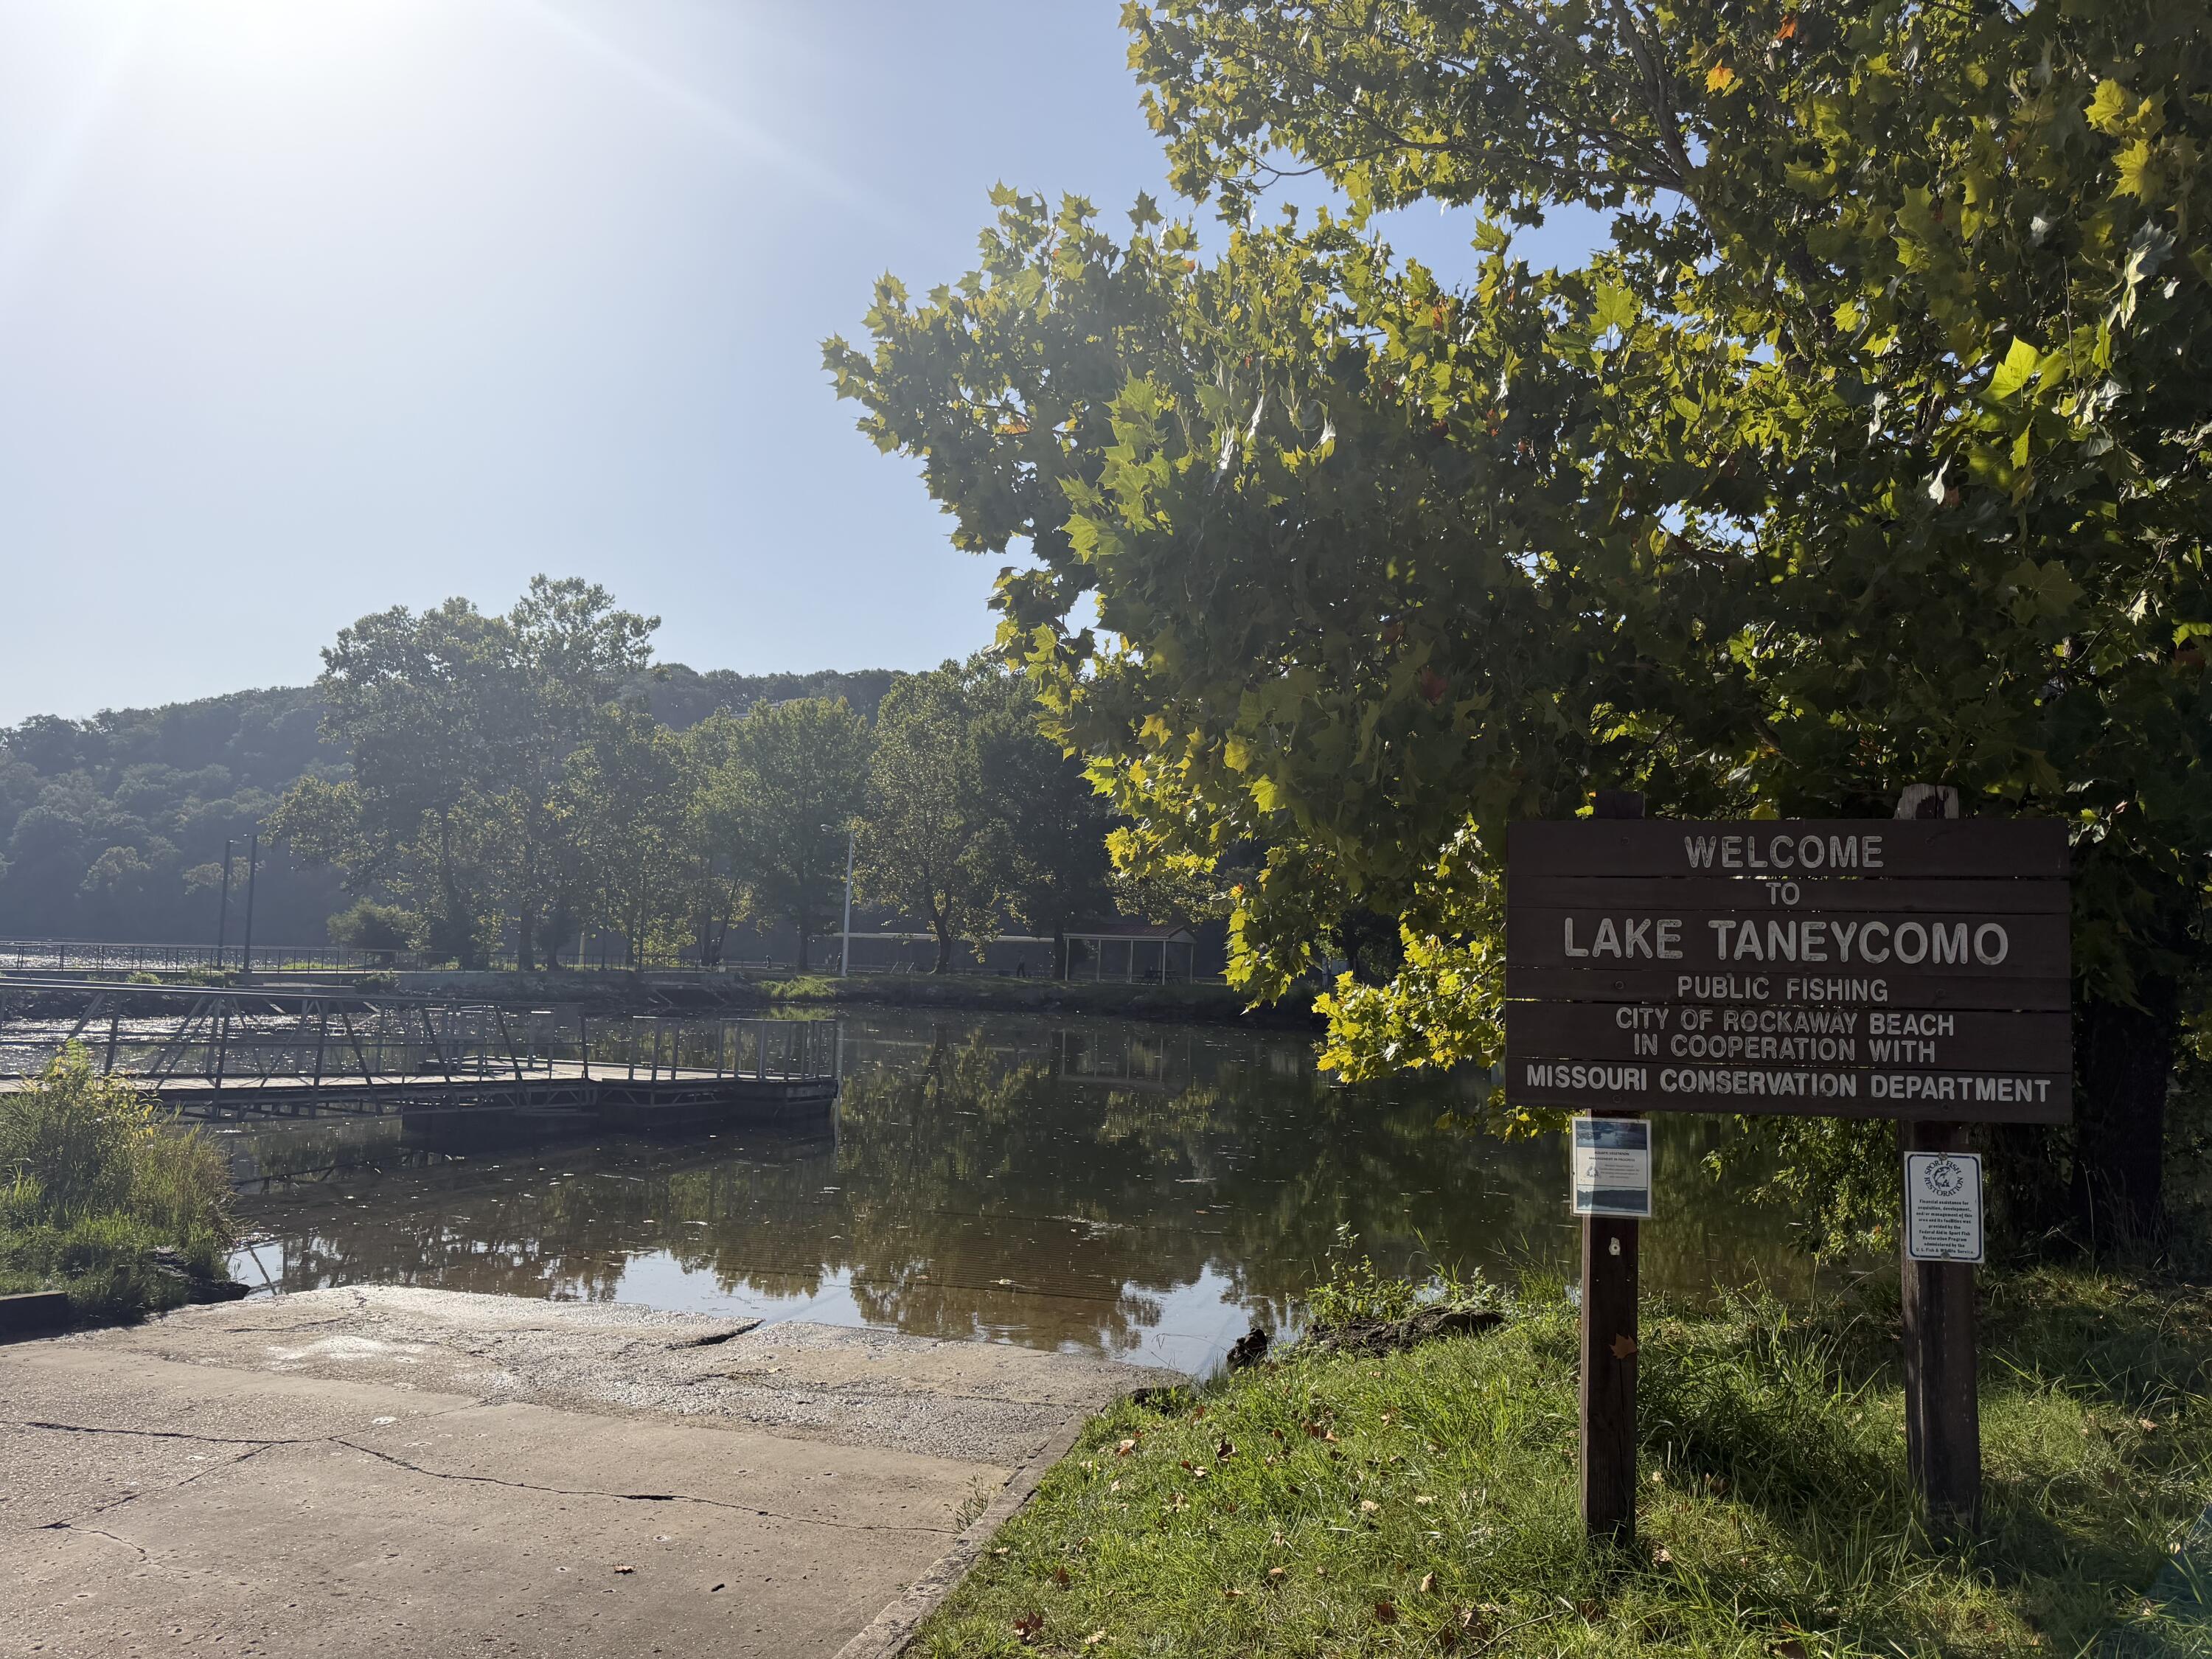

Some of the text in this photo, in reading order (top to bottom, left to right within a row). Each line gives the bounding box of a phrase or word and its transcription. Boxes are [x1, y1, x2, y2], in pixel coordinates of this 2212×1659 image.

[1685, 834, 1884, 869] WELCOME
[1765, 882, 1800, 905] TO
[1564, 917, 2009, 965] LAKE TANEYCOMO
[1677, 976, 1888, 1002] PUBLIC FISHING
[1615, 1007, 1954, 1035] CITY OF ROCKAWAY BEACH
[1634, 1034, 1935, 1062] IN COOPERATION WITH
[1526, 1065, 2051, 1102] MISSOURI CONSERVATION DEPARTMENT
[1924, 1160, 1961, 1175] SPORT FISH
[1924, 1177, 1964, 1197] RESTORATION
